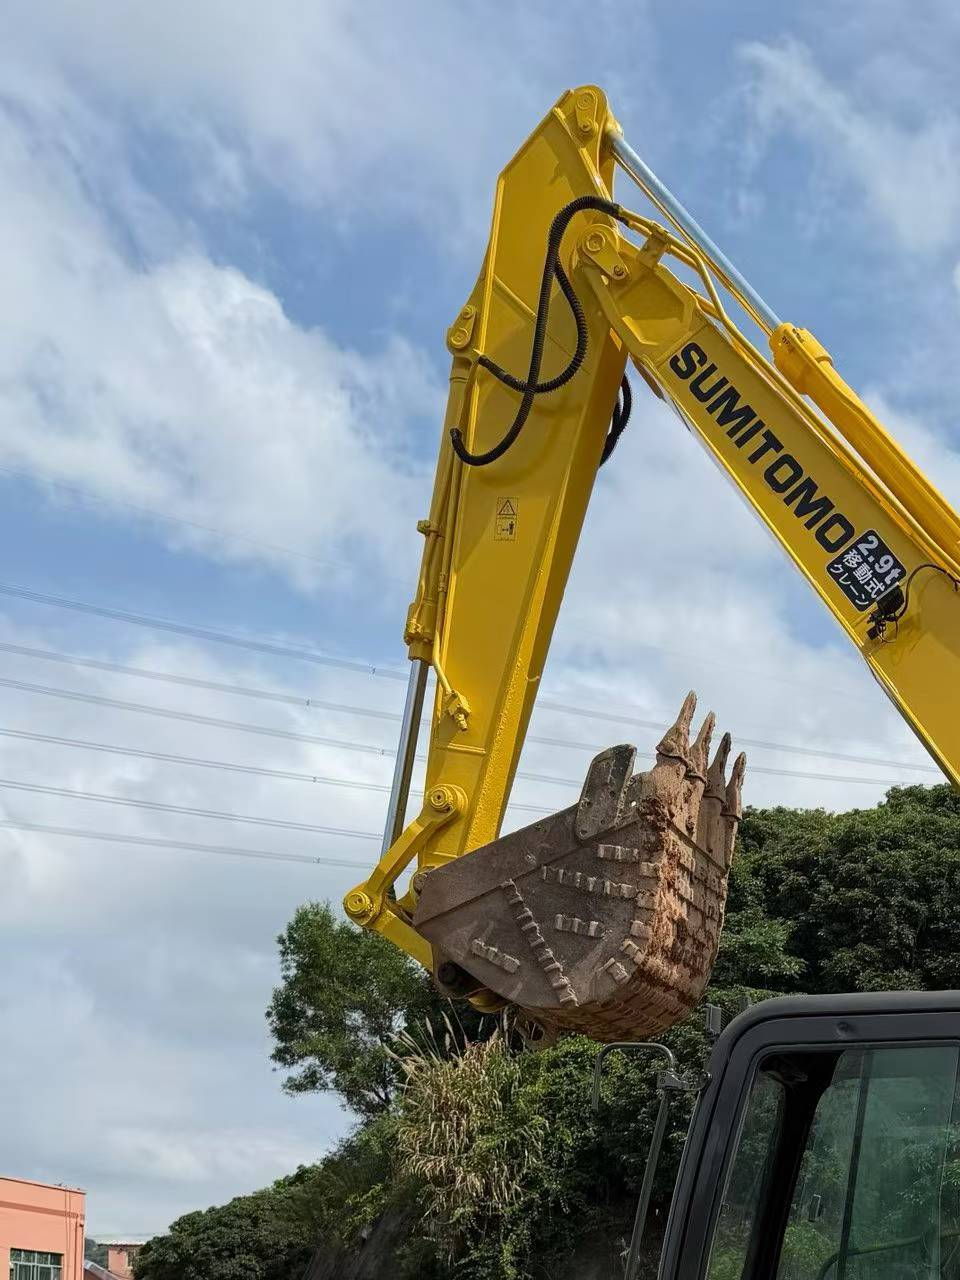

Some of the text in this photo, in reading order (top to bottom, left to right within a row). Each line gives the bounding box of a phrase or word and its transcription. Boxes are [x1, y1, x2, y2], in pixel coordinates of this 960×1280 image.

[669, 342, 854, 553] SUMITOMO
[843, 549, 885, 598] 移動式
[857, 535, 901, 584] 2.9t
[830, 564, 869, 605] クレーン
